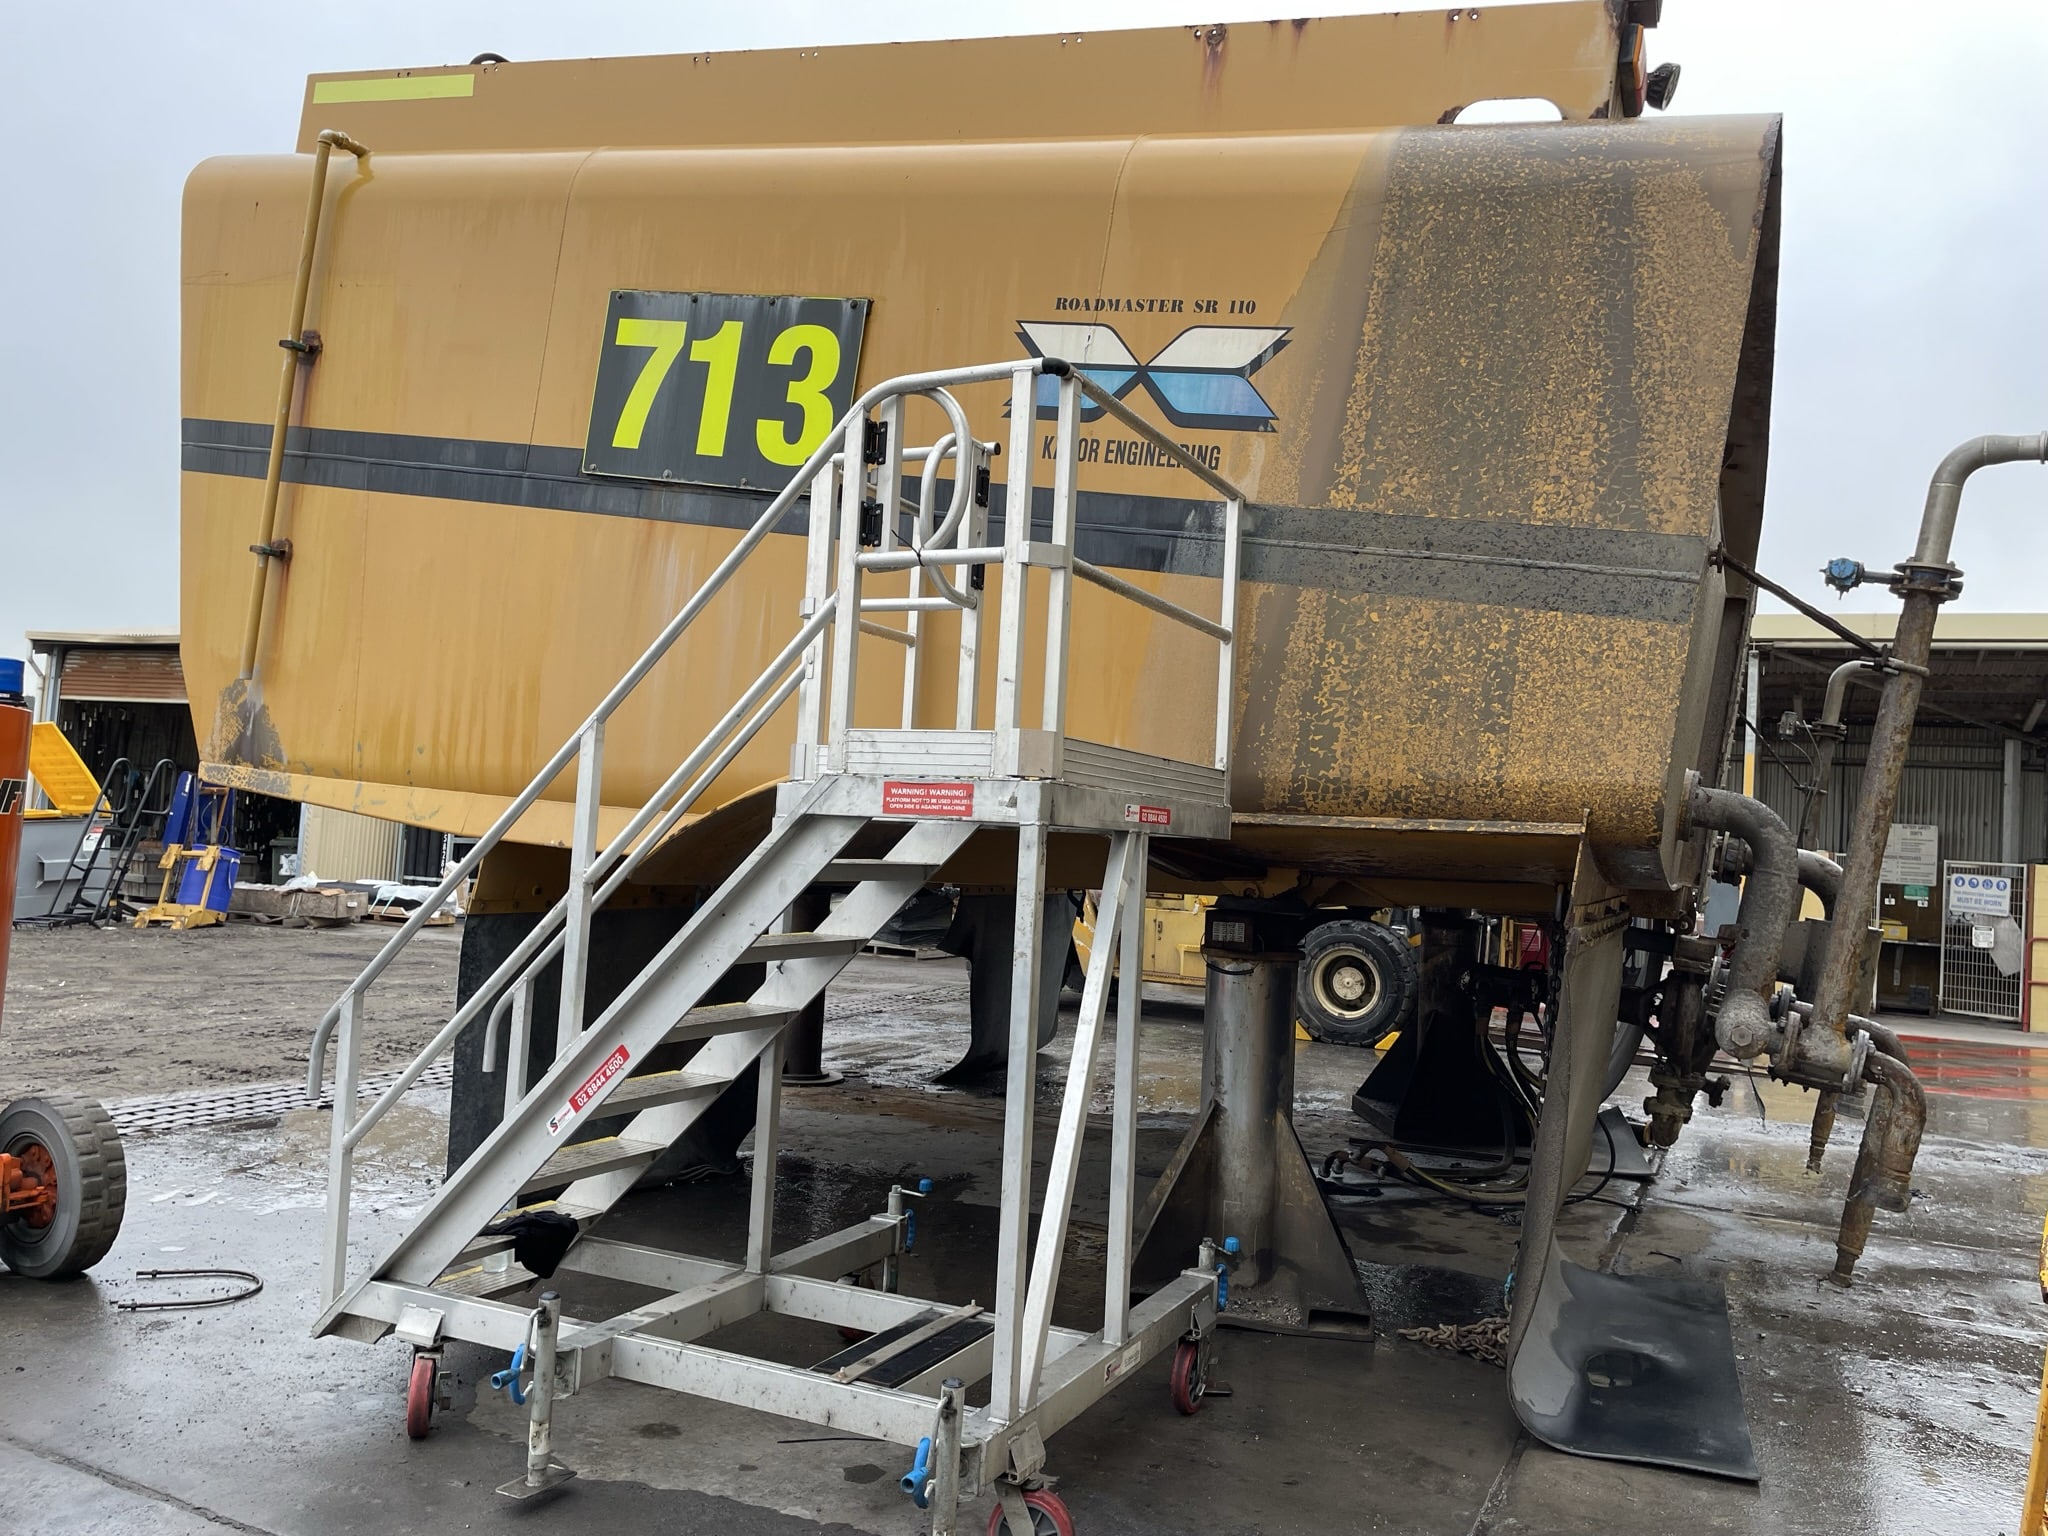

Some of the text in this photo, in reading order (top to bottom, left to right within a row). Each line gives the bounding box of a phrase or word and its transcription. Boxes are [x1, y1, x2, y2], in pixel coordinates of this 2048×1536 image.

[1054, 297, 1256, 315] ROADMASTER SR 110
[611, 318, 841, 467] 713
[1042, 435, 1100, 463] KOR
[890, 787, 967, 797] WARNING! WARNING!
[1957, 896, 1973, 904] MUST
[1984, 899, 2003, 907] WORN
[576, 1055, 624, 1107] 02 8844 4500
